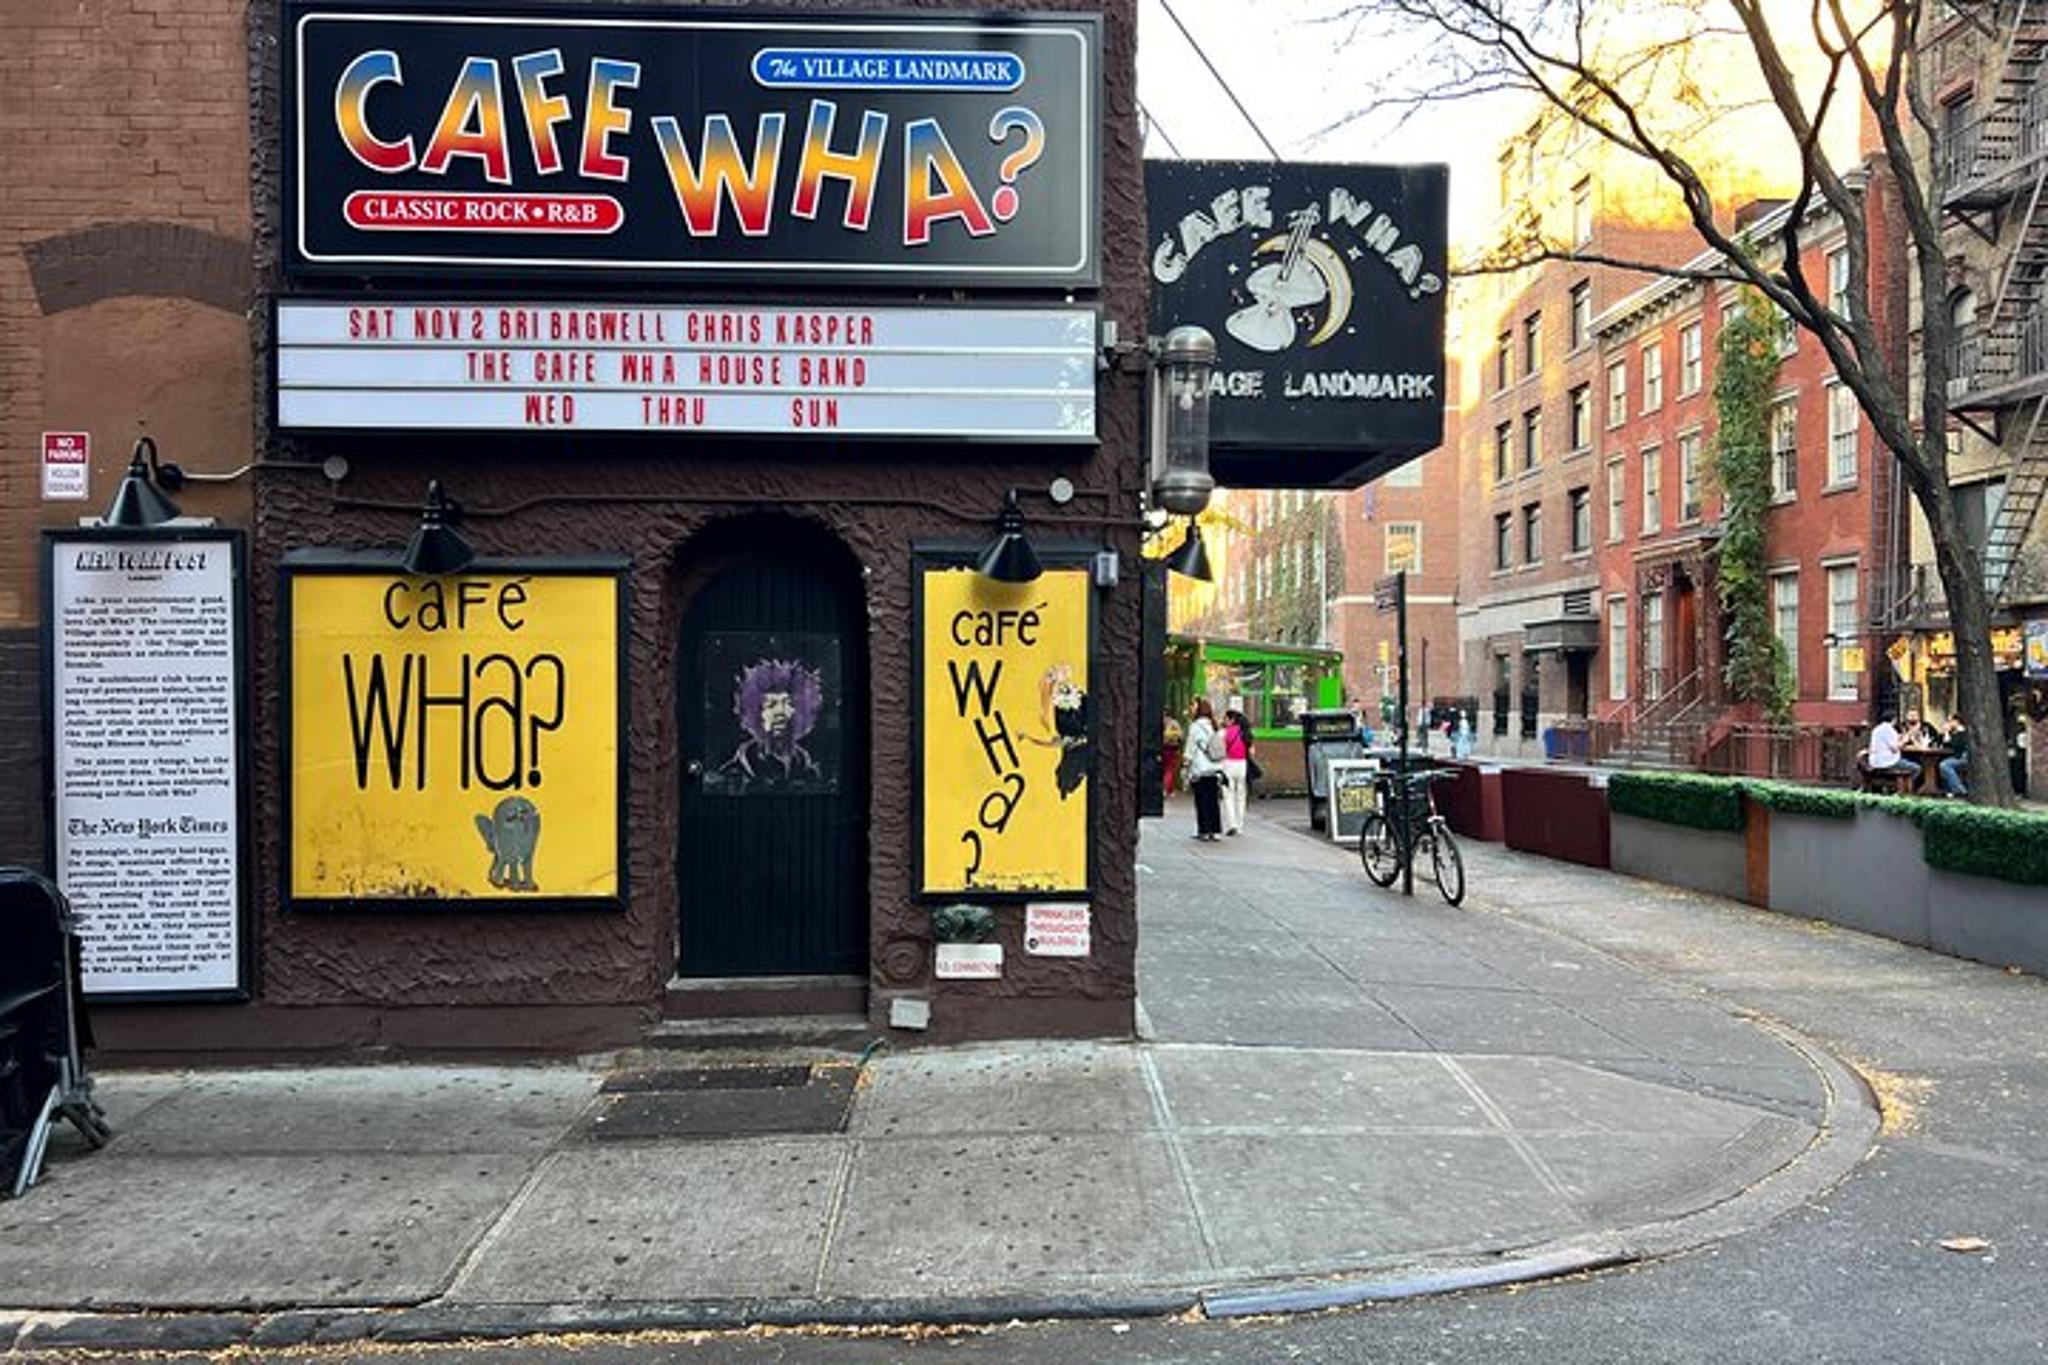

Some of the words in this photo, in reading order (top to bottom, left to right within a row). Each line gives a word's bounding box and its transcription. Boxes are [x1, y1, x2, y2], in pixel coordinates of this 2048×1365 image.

[769, 59, 797, 77] The
[802, 59, 888, 79] VILLAGE
[894, 60, 1011, 82] LANDMARK
[335, 48, 641, 185] CAFE
[650, 99, 1045, 245] WHA?
[364, 199, 462, 220] CLASSIC
[1153, 186, 1274, 283] CAFE
[349, 308, 394, 338] SAT
[500, 311, 540, 341] BRI
[551, 311, 665, 343] BAGWELL
[687, 312, 762, 343] CHRIS
[775, 314, 873, 345] KASPER
[466, 352, 512, 382] THE
[534, 352, 595, 383] CAFE
[621, 353, 675, 384] WHA
[700, 355, 781, 385] HOUSE
[800, 356, 866, 387] BAND
[1284, 371, 1435, 399] LANDMARK
[525, 395, 574, 425] WED
[641, 397, 705, 426] THRU
[792, 399, 838, 428] SUN
[57, 438, 74, 450] NO
[67, 818, 97, 837] The
[101, 818, 134, 836] New
[137, 817, 177, 840] York
[179, 815, 228, 835] Times
